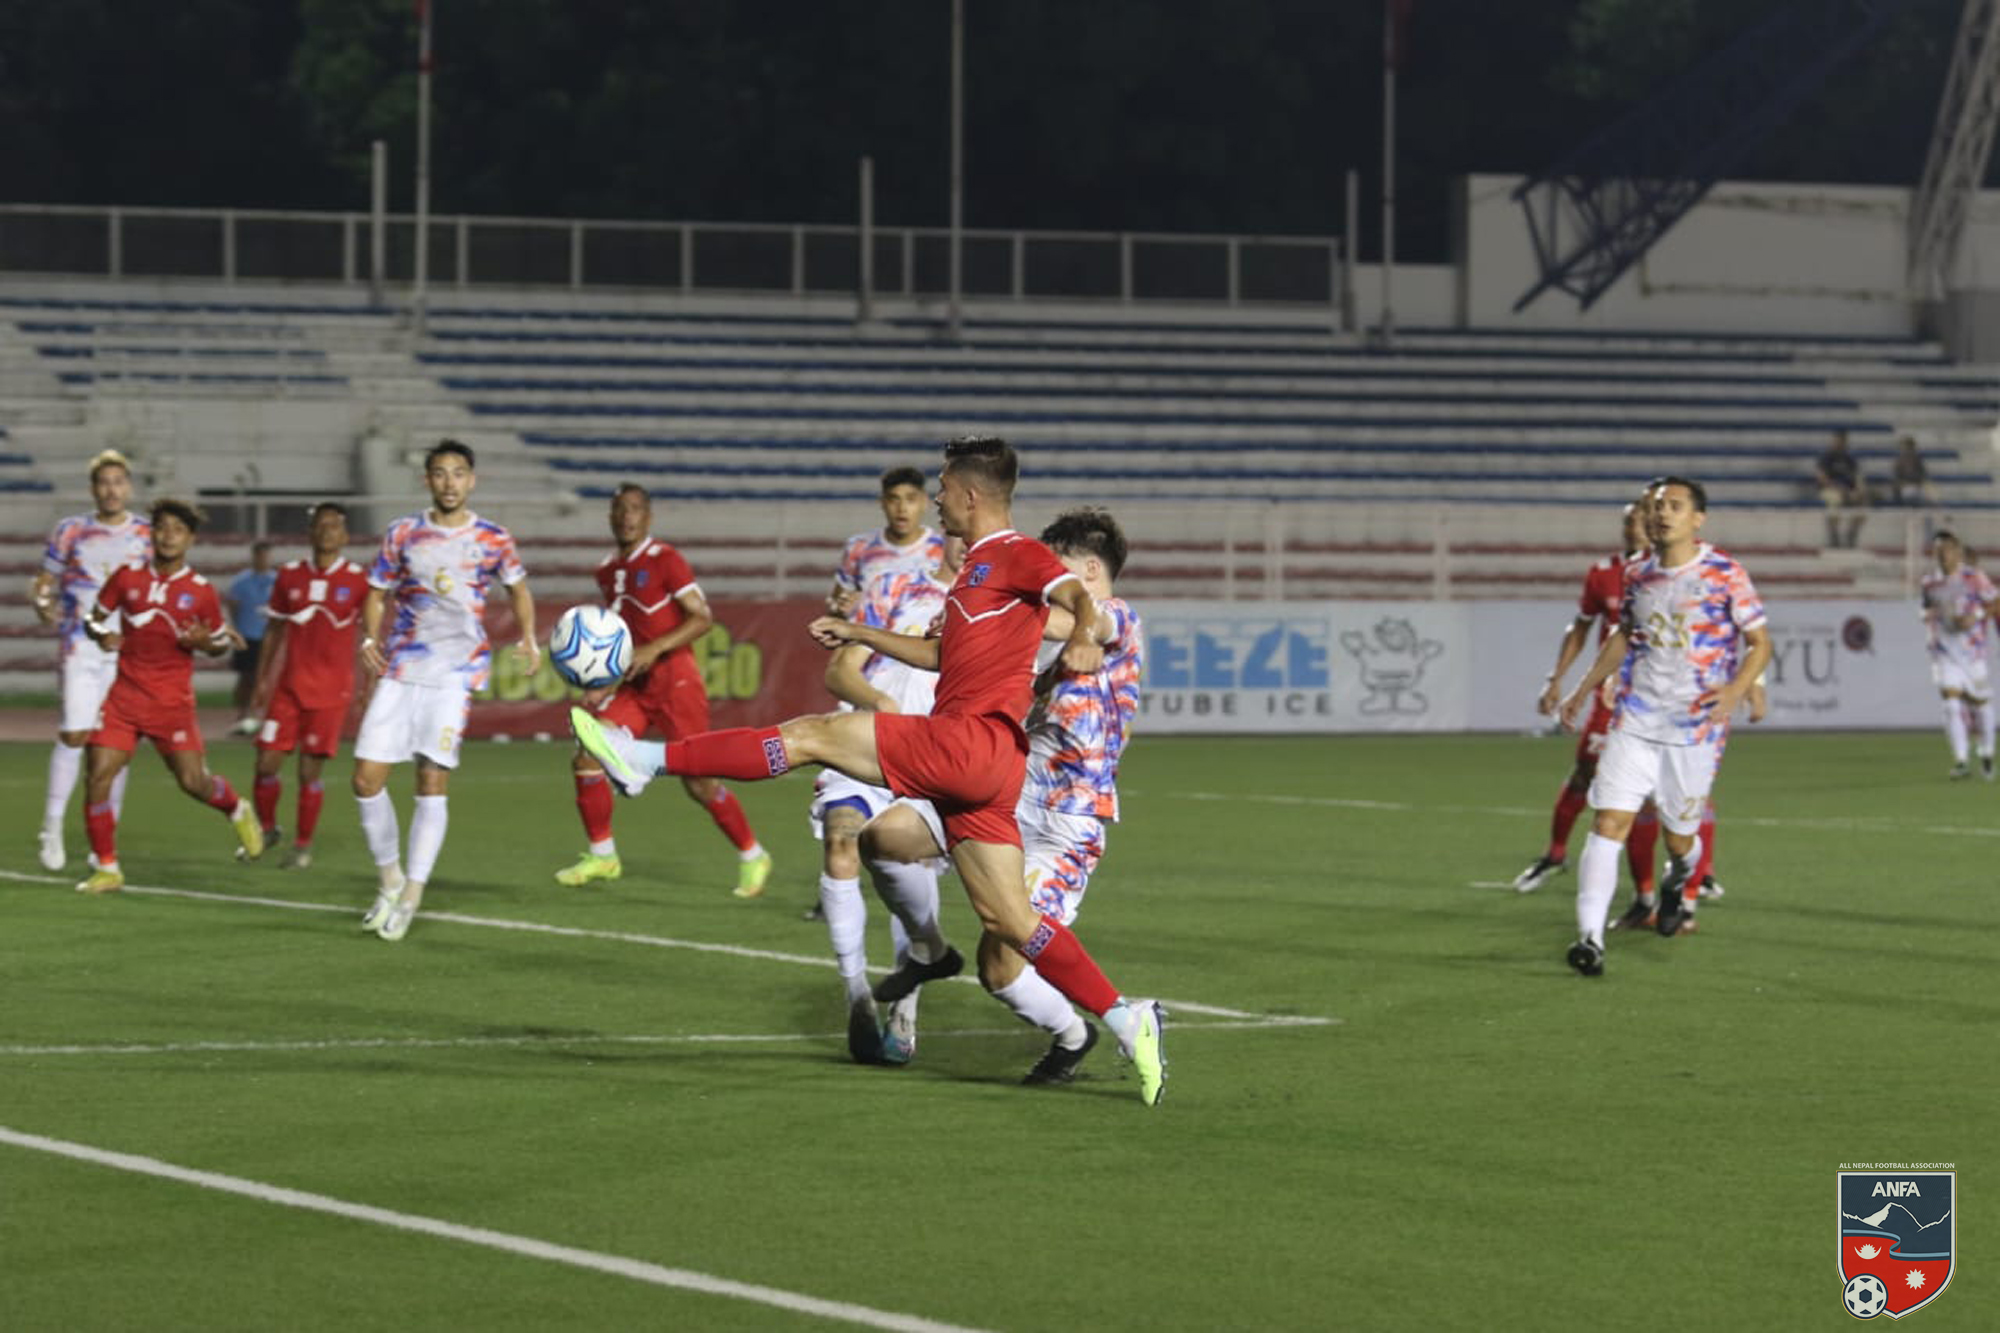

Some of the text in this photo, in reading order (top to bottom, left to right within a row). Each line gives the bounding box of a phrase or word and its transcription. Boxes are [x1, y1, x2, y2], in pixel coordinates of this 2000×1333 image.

[434, 566, 454, 594] 6
[1649, 612, 1688, 648] 23
[1140, 693, 1334, 716] TUBE ICE
